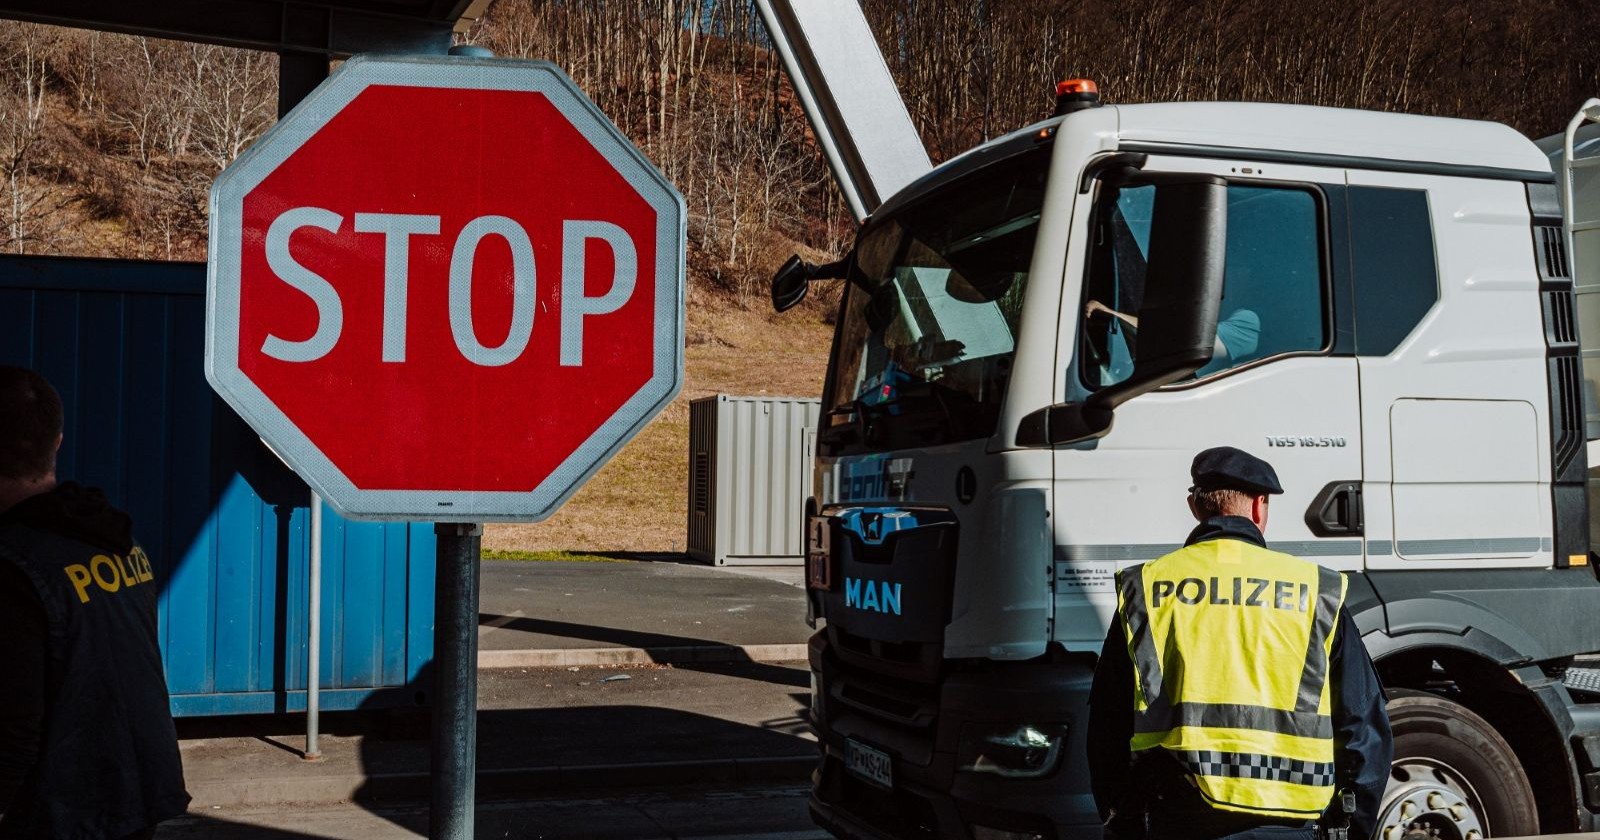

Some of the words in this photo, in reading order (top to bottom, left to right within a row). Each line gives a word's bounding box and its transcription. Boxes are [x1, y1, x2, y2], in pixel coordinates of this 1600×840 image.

[260, 206, 638, 367] STOP
[1265, 435, 1297, 447] TGS
[1299, 435, 1347, 447] 18.510
[845, 576, 902, 616] MAN
[1152, 576, 1308, 613] POLIZEI
